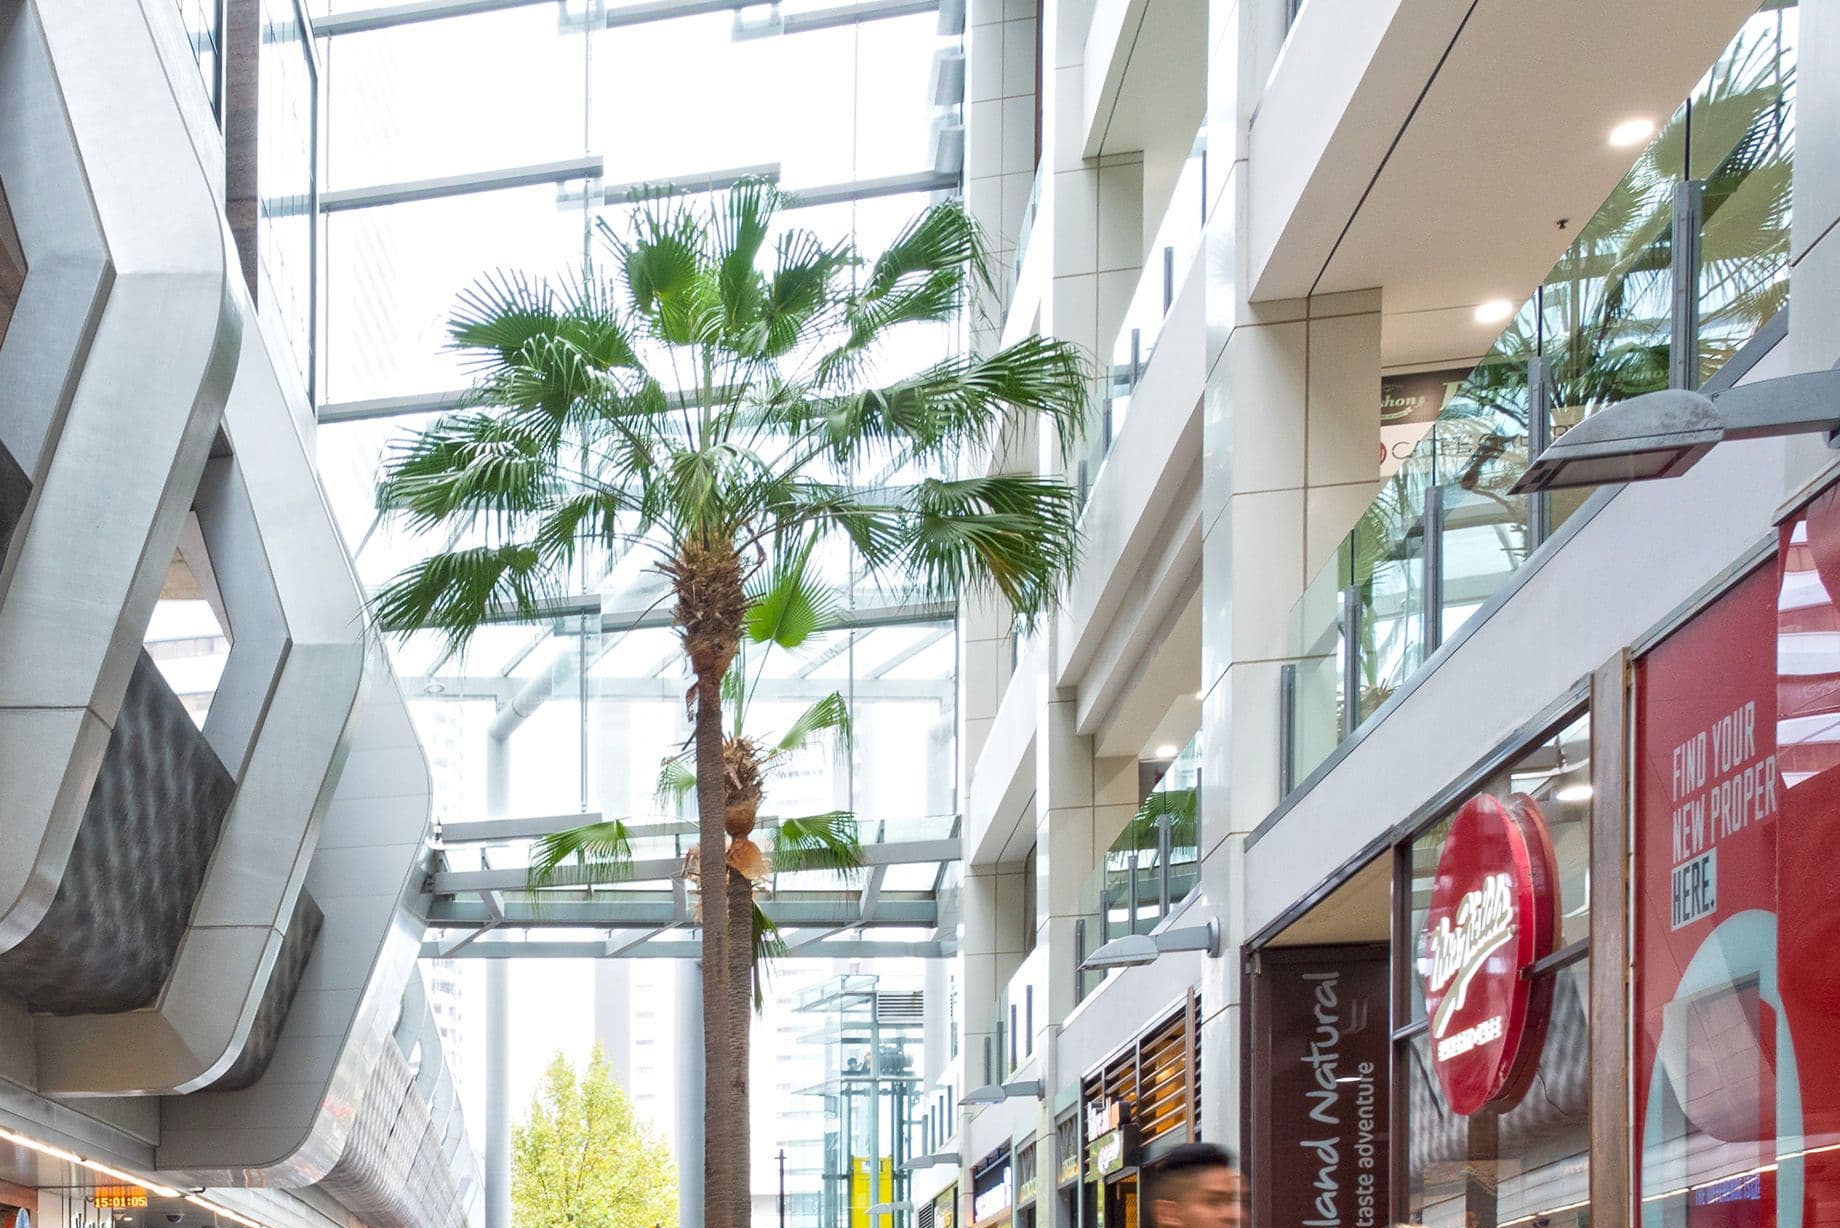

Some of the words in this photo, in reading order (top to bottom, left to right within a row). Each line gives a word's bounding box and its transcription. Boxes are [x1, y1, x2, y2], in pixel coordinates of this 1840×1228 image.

[1673, 731, 1706, 802] FIND
[1712, 700, 1755, 778] YOUR
[1673, 794, 1705, 864] NEW
[1673, 856, 1715, 926] HERE.
[1301, 971, 1340, 1124] Natural
[1354, 1061, 1375, 1168] adventure
[95, 1196, 146, 1208] 15:01:05
[1356, 1173, 1375, 1226] taste
